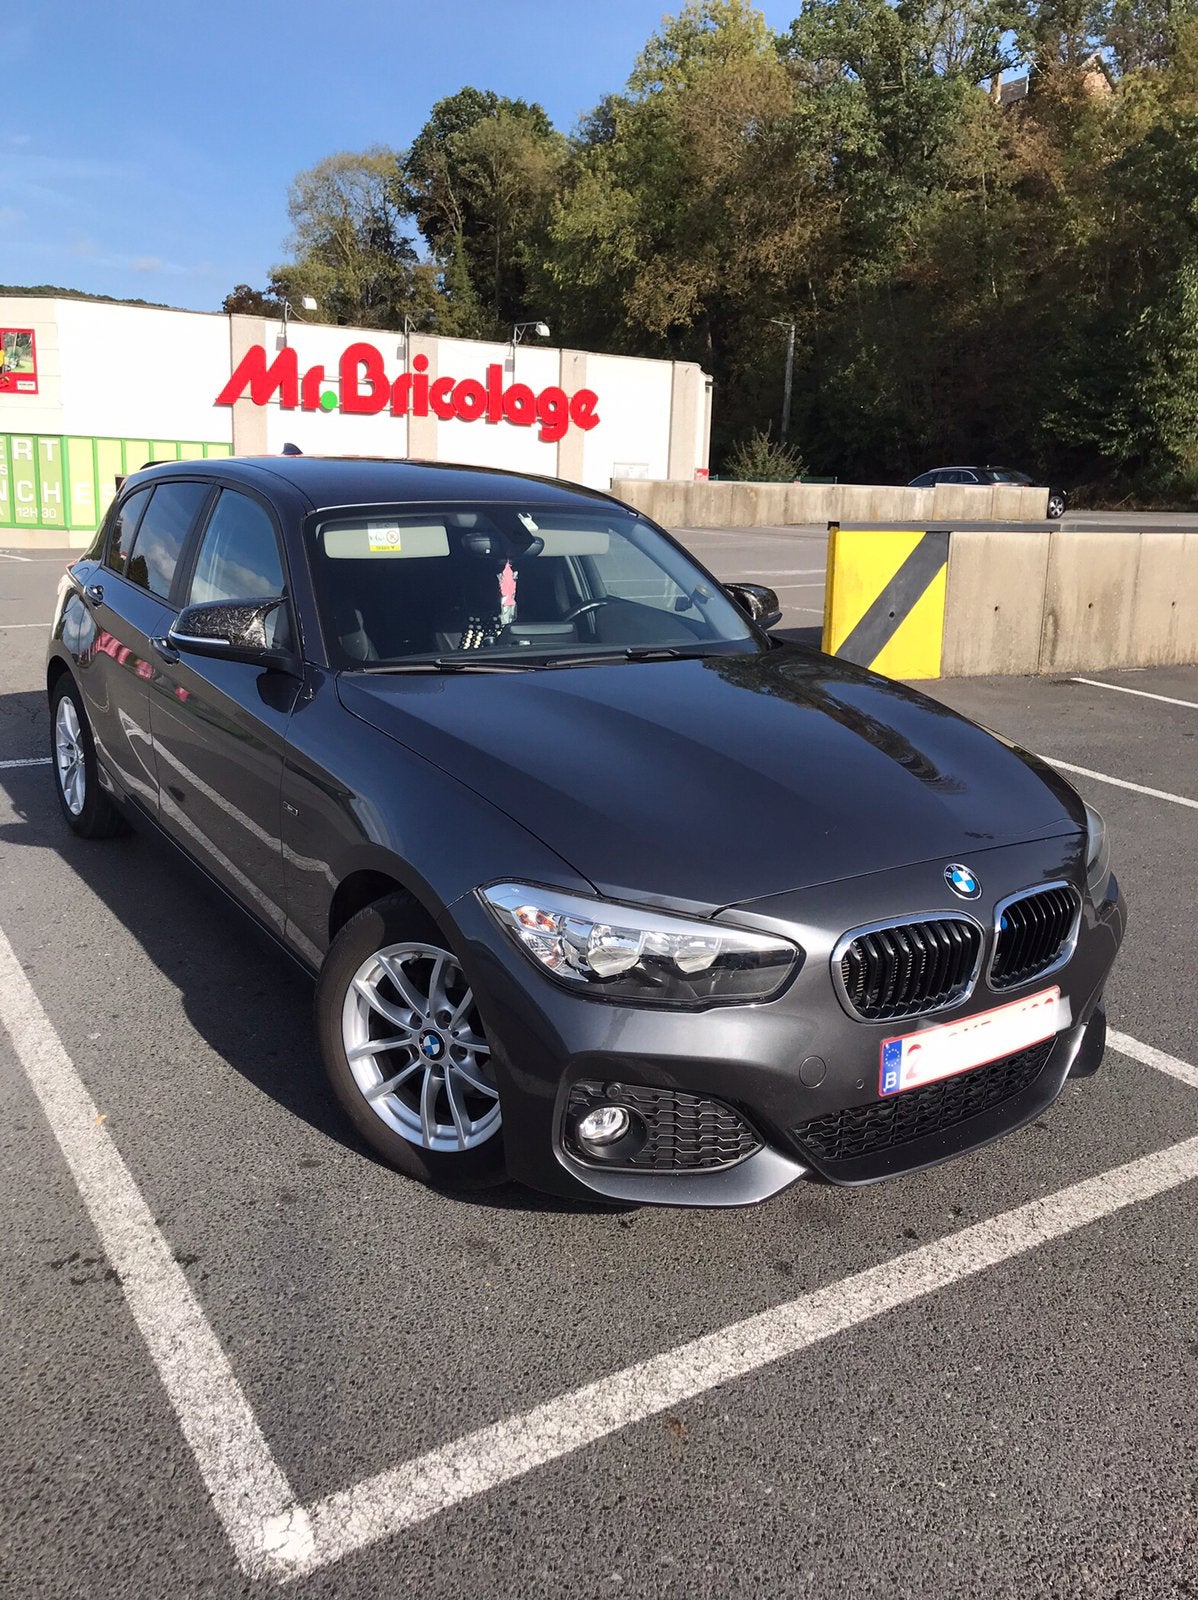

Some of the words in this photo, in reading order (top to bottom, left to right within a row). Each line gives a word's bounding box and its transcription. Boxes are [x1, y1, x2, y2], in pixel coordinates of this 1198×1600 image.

[216, 344, 338, 411] Mr.
[338, 342, 600, 441] Bricolage
[886, 1072, 897, 1088] B
